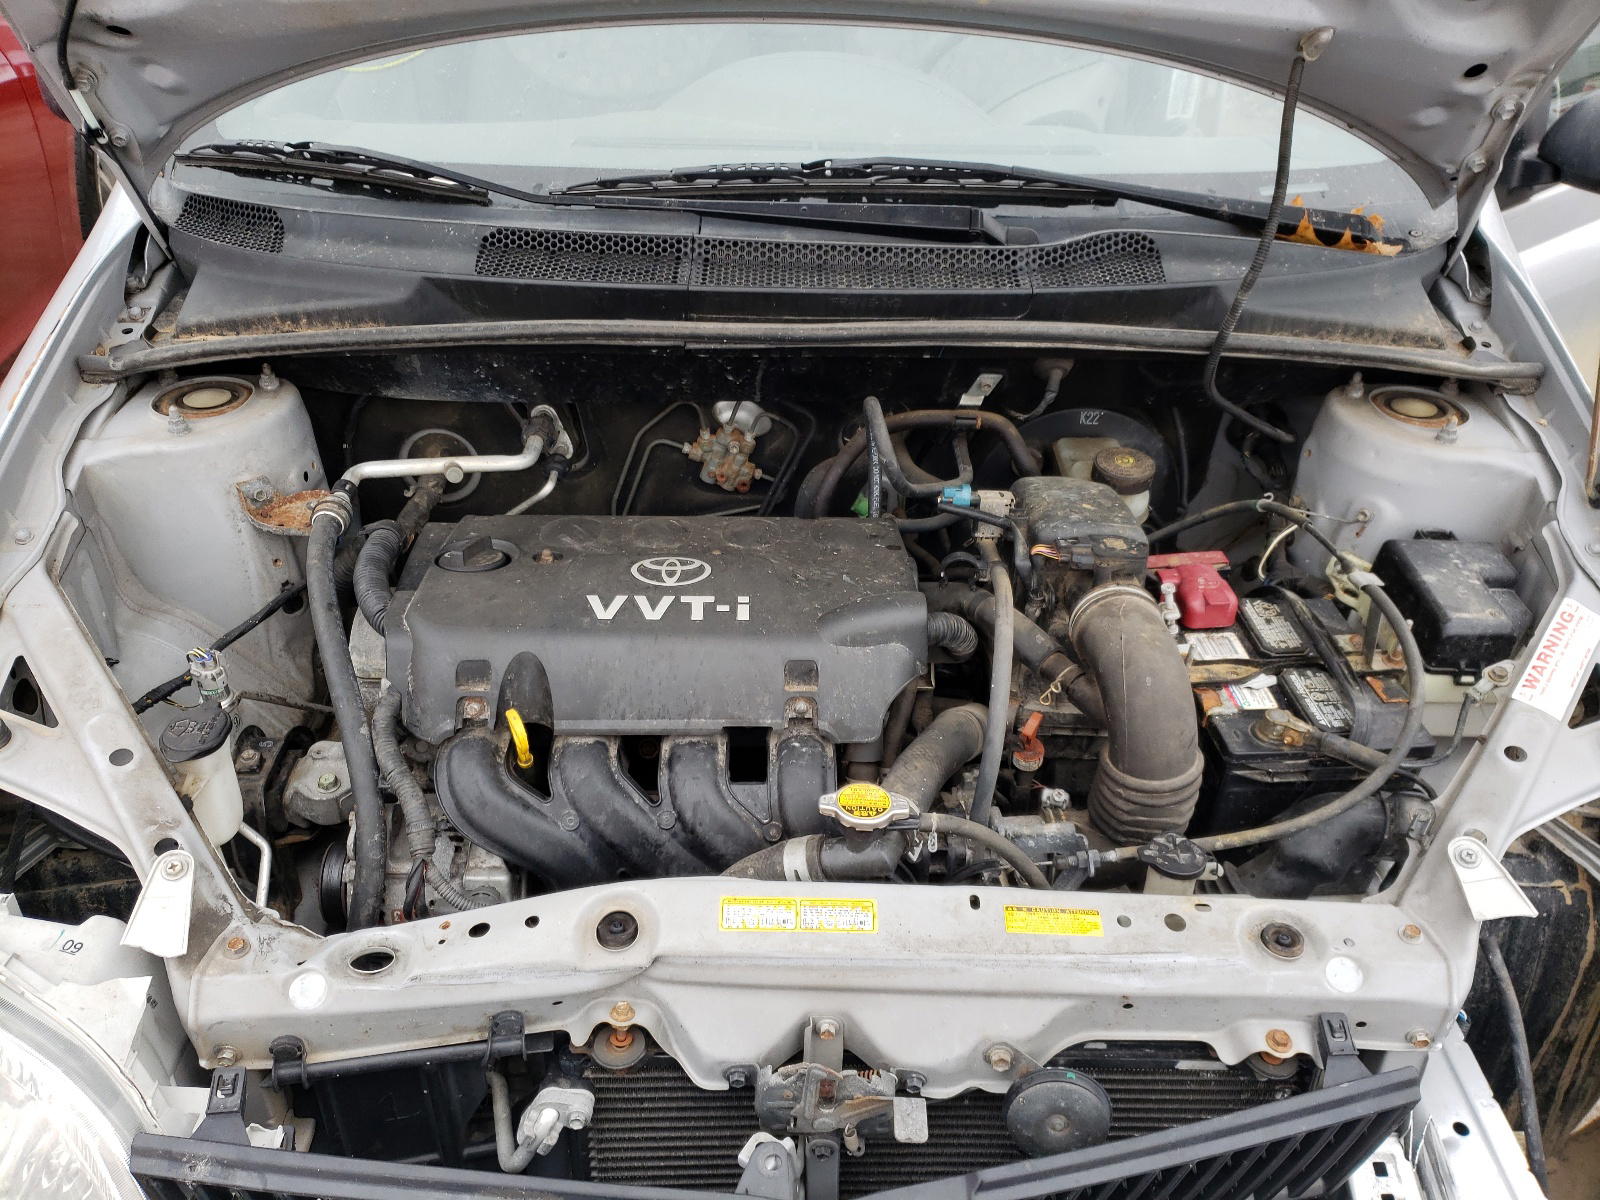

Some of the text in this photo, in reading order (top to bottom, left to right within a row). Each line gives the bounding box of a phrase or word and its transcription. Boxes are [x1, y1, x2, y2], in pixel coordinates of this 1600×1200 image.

[585, 594, 750, 621] VVT-i
[1522, 611, 1575, 690] WARNING
[845, 804, 884, 813] CAUTION
